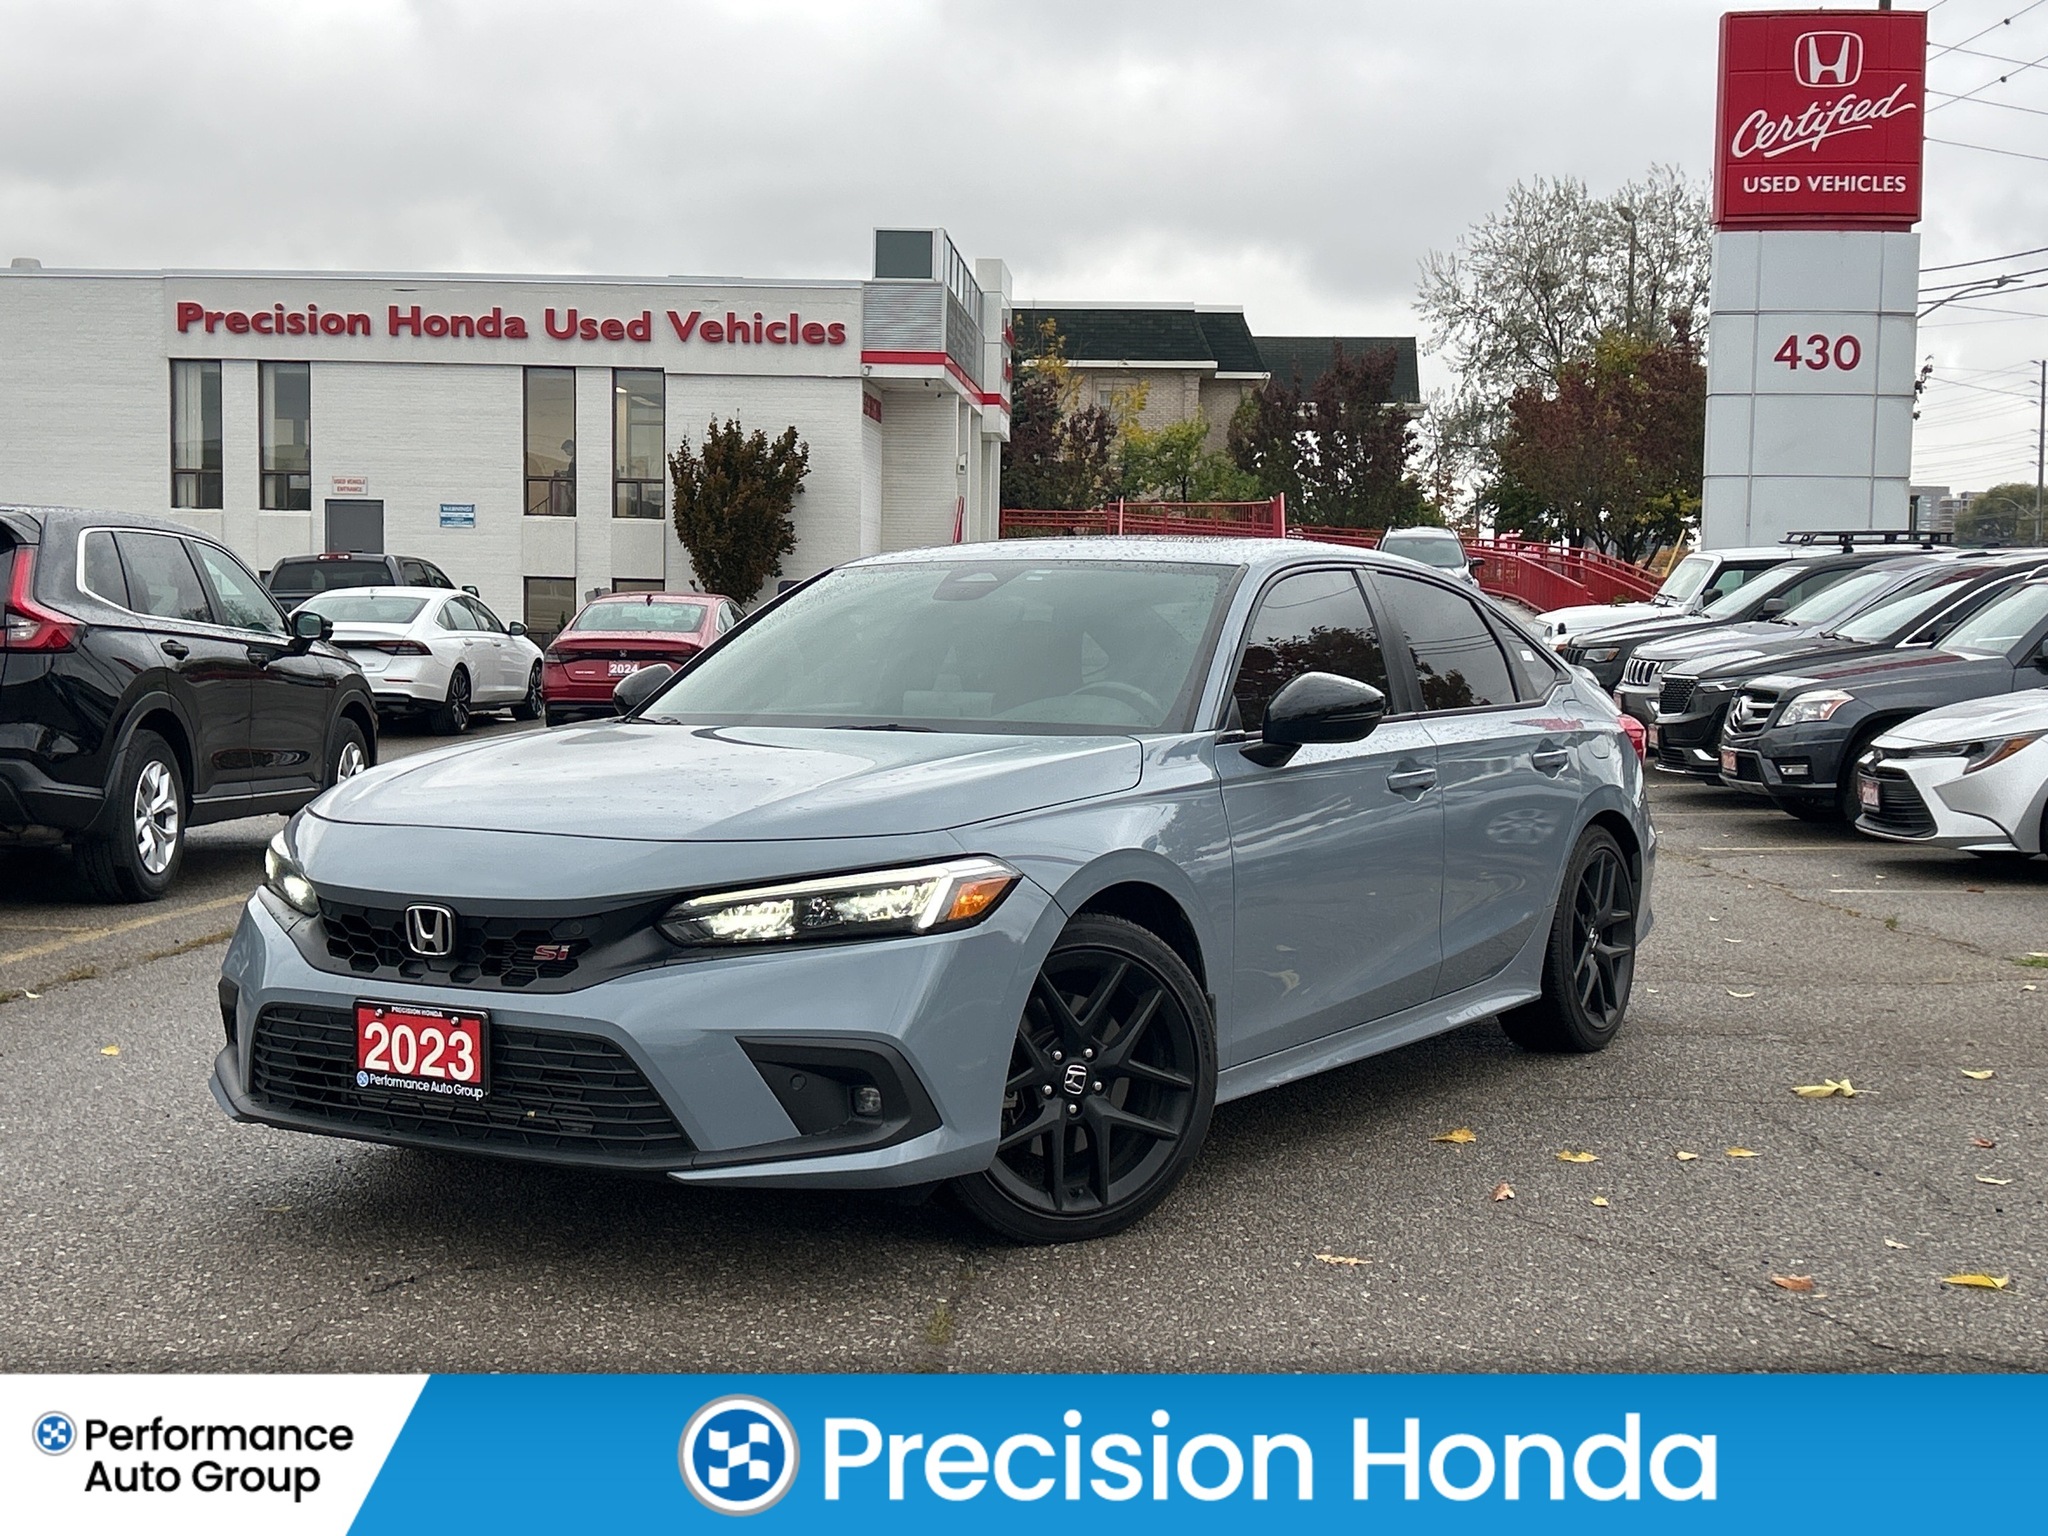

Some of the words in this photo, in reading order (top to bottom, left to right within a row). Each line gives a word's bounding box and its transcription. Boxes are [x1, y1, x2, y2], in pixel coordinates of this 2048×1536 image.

[1731, 83, 1916, 158] Certified
[1743, 176, 1800, 193] USED
[1807, 175, 1906, 192] VEHICLES
[177, 302, 371, 336] Precision
[388, 306, 527, 339] Honda
[545, 309, 651, 342] Used
[668, 311, 846, 345] Vehicles
[1774, 335, 1861, 371] 430
[610, 664, 638, 674] 2024
[391, 1006, 421, 1015] PRECISION
[421, 1009, 443, 1017] HONDA
[364, 1021, 475, 1081] 2023
[370, 1073, 430, 1091] Performance
[430, 1081, 453, 1094] Auto
[453, 1083, 484, 1101] Group
